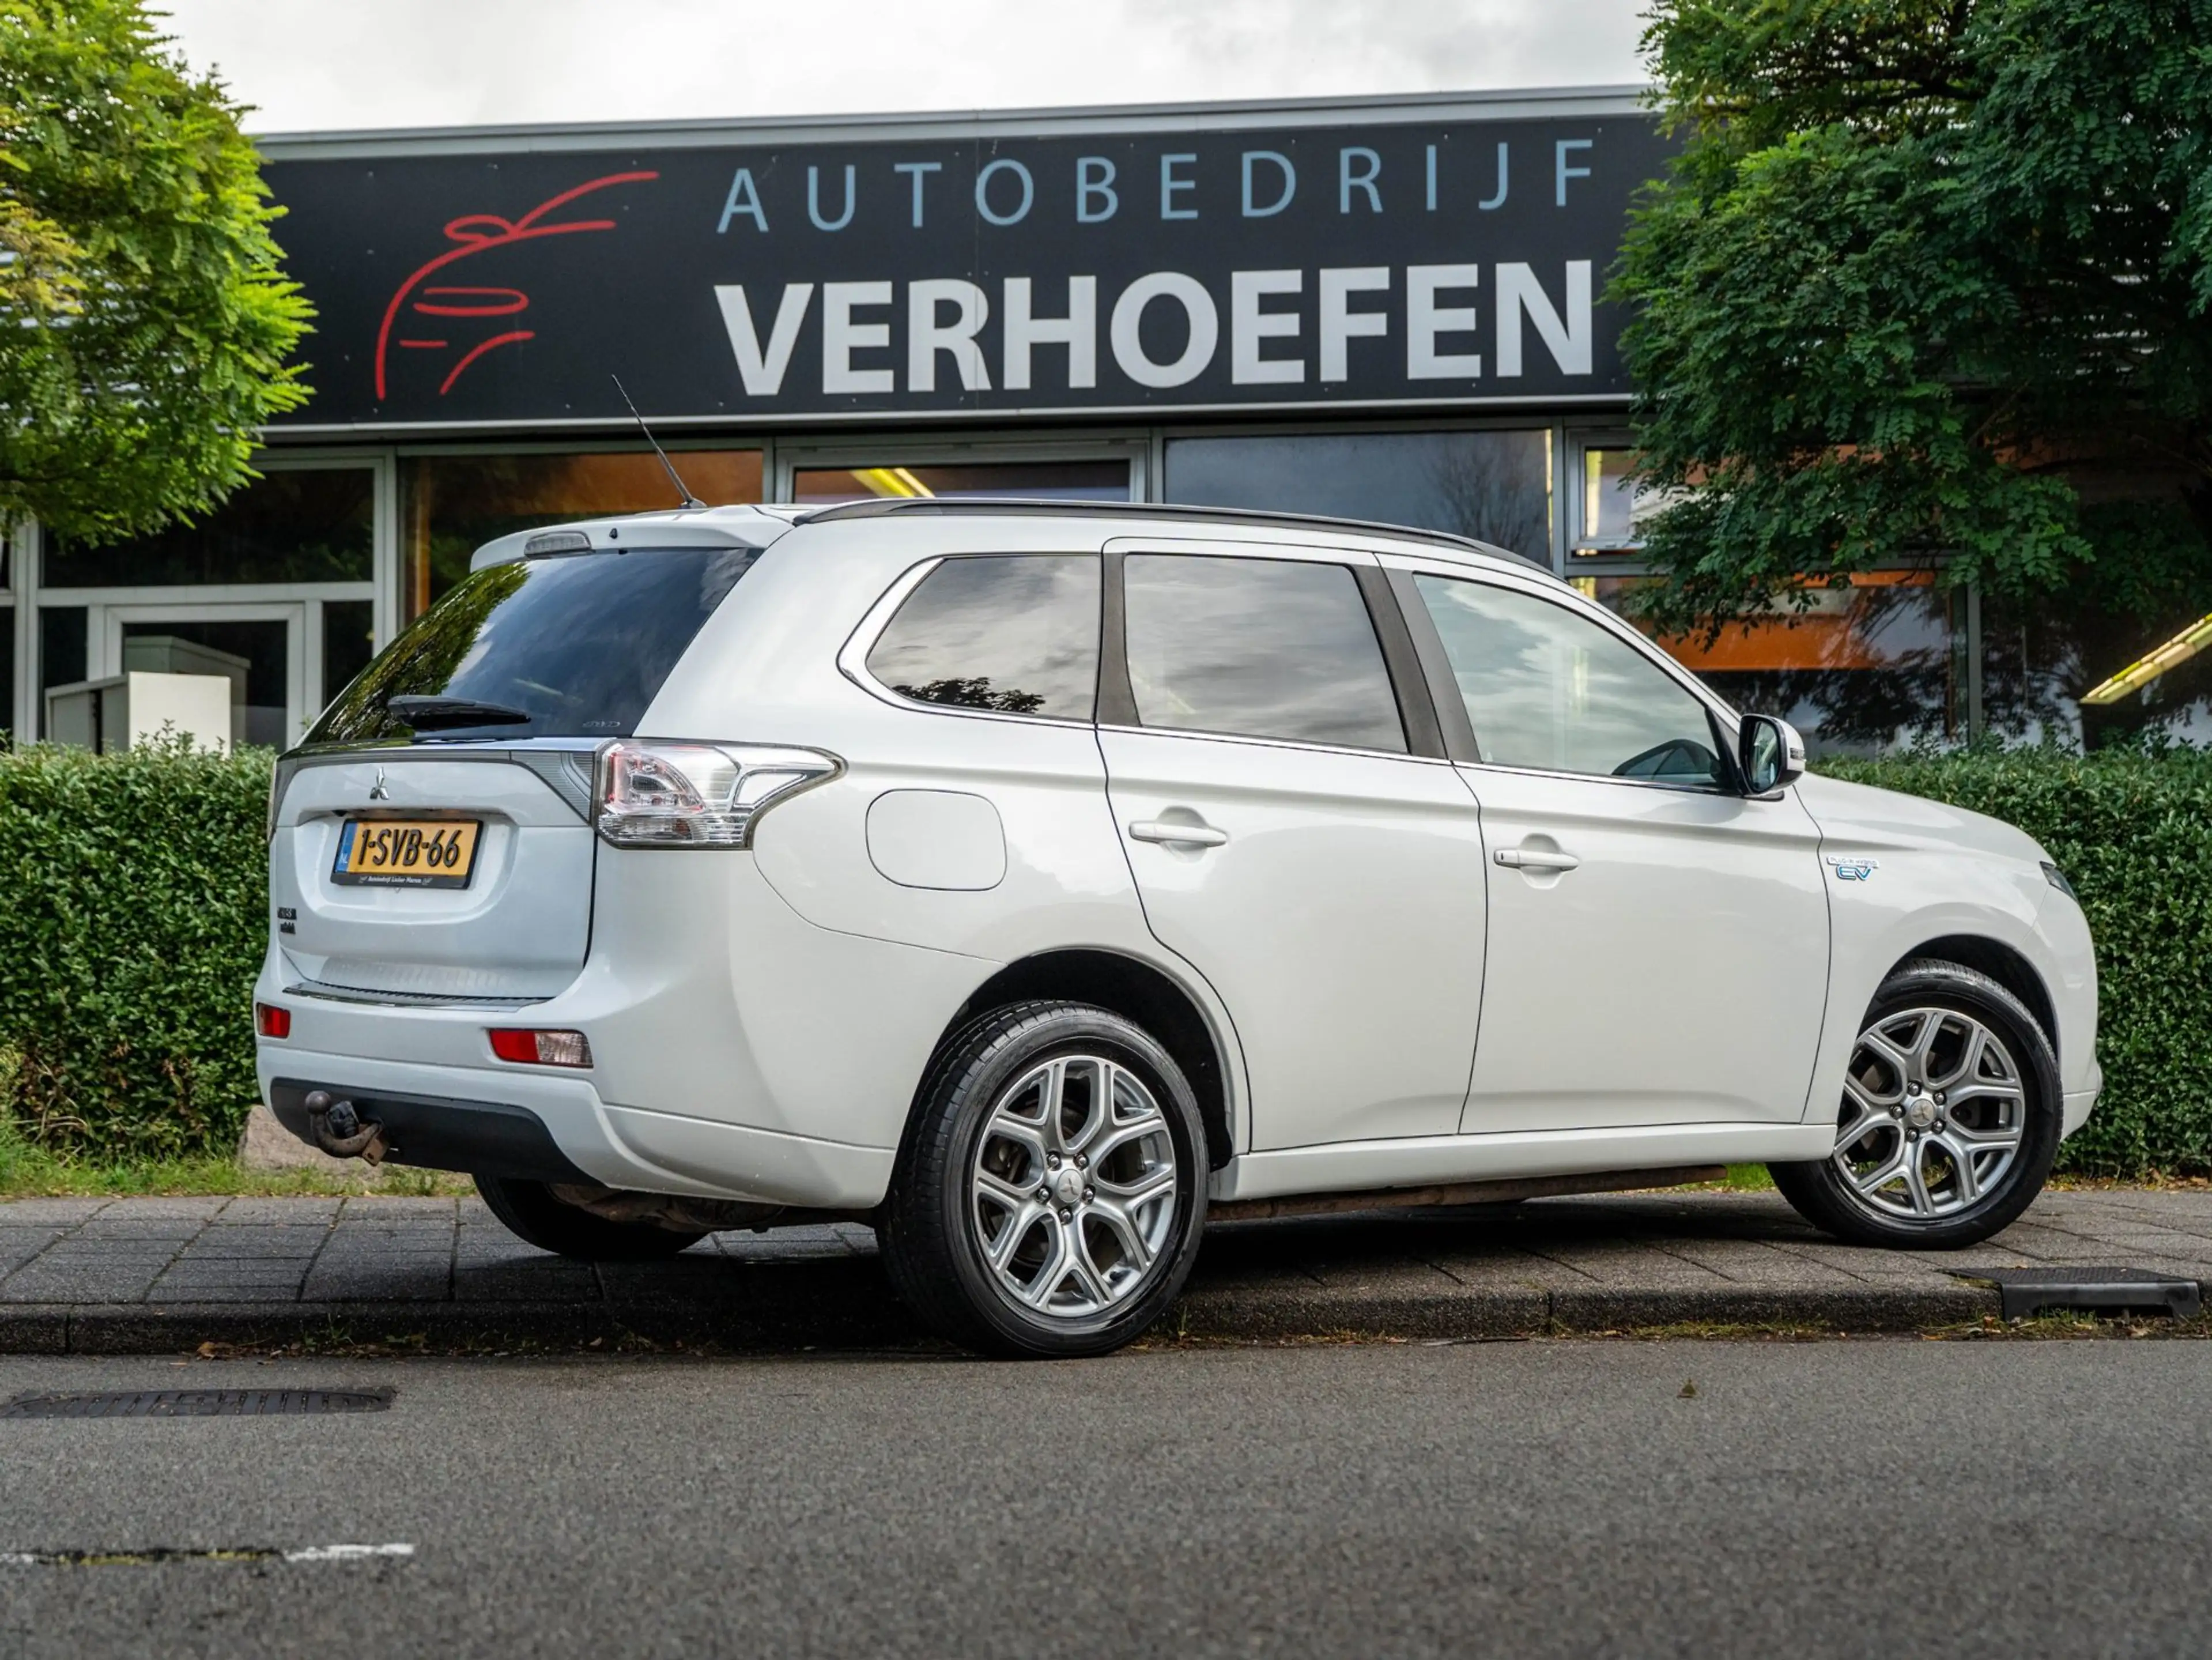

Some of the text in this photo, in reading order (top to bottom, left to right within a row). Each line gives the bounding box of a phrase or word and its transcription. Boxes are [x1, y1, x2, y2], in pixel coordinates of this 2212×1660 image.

[717, 139, 1593, 233] AUTOBEDRIJF
[714, 259, 1592, 396] VERHOEFEN
[358, 828, 462, 868] 1-SVB-66
[1837, 865, 1873, 881] EV
